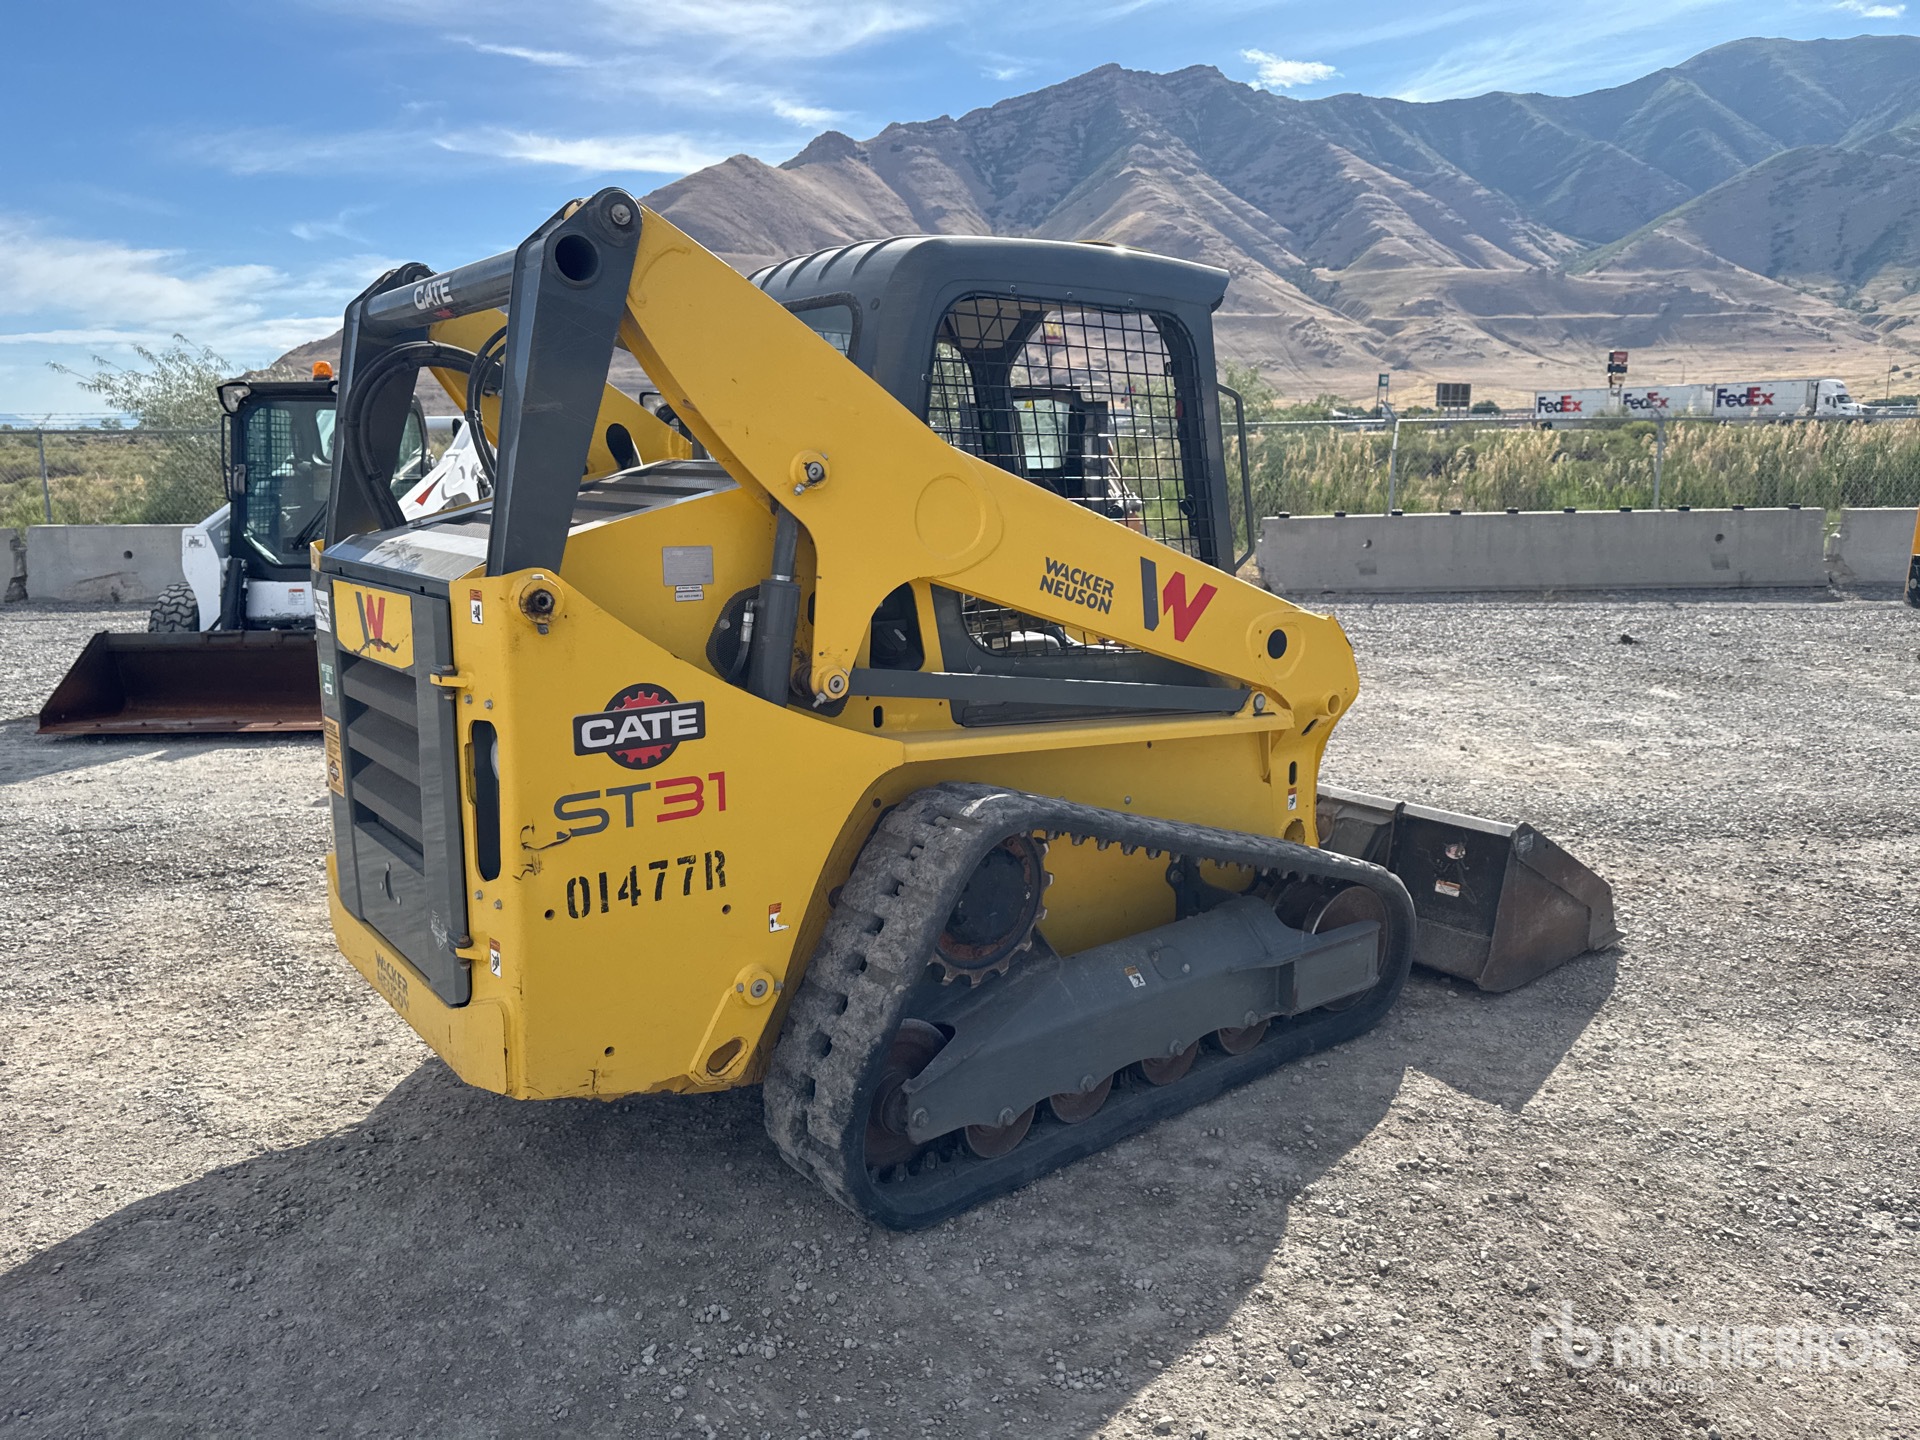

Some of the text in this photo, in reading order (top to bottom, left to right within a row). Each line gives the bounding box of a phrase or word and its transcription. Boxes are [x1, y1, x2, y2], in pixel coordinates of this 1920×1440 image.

[414, 277, 454, 310] CATE
[1537, 395, 1582, 414] FedEx
[1623, 391, 1669, 411] FedEx
[1715, 387, 1775, 408] FedEx
[1039, 575, 1112, 615] NEUSON
[1045, 556, 1115, 598] WACKER
[581, 708, 698, 748] CATE
[553, 771, 727, 841] ST31
[566, 850, 727, 919] 01477R
